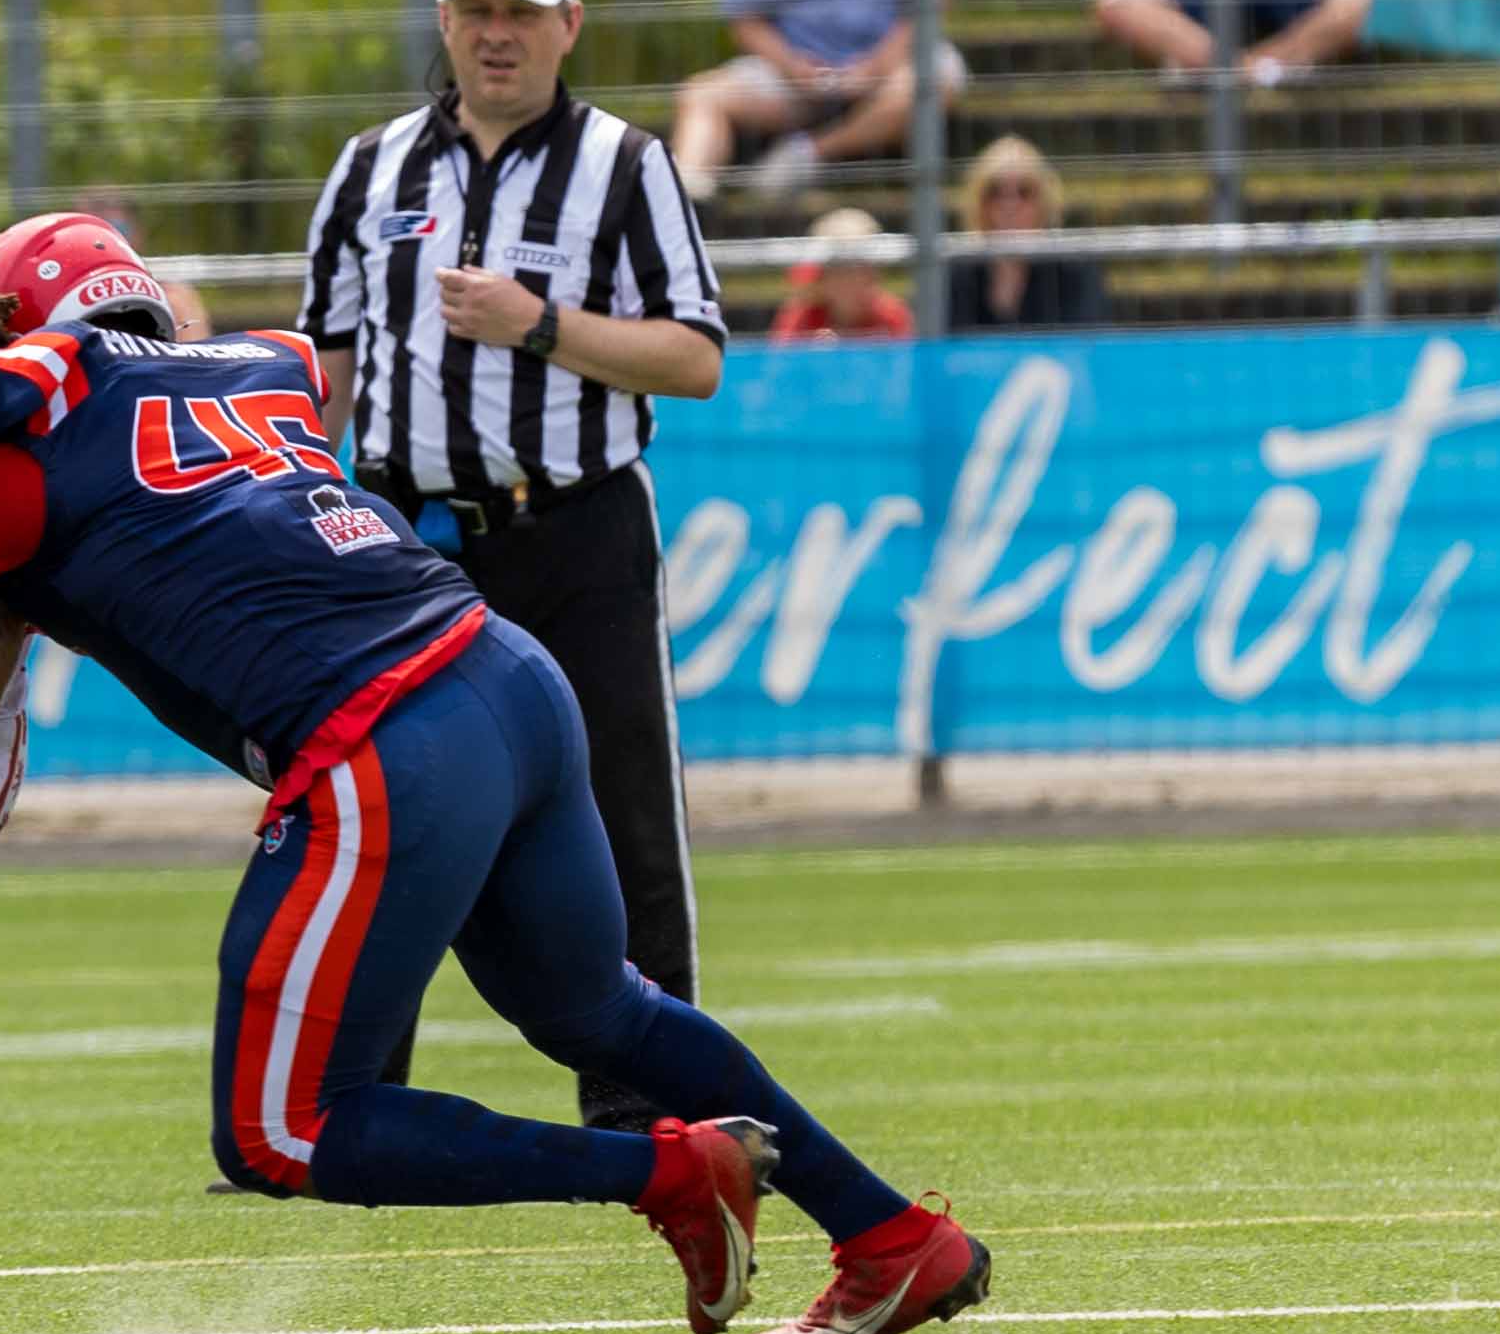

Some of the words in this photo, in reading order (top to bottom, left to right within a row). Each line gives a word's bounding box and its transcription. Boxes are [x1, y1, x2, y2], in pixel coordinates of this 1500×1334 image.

[504, 245, 572, 267] CITIZEN
[86, 273, 162, 303] GAZI
[132, 389, 346, 495] 45
[317, 509, 383, 533] BLOCK
[326, 521, 393, 547] HOUSE
